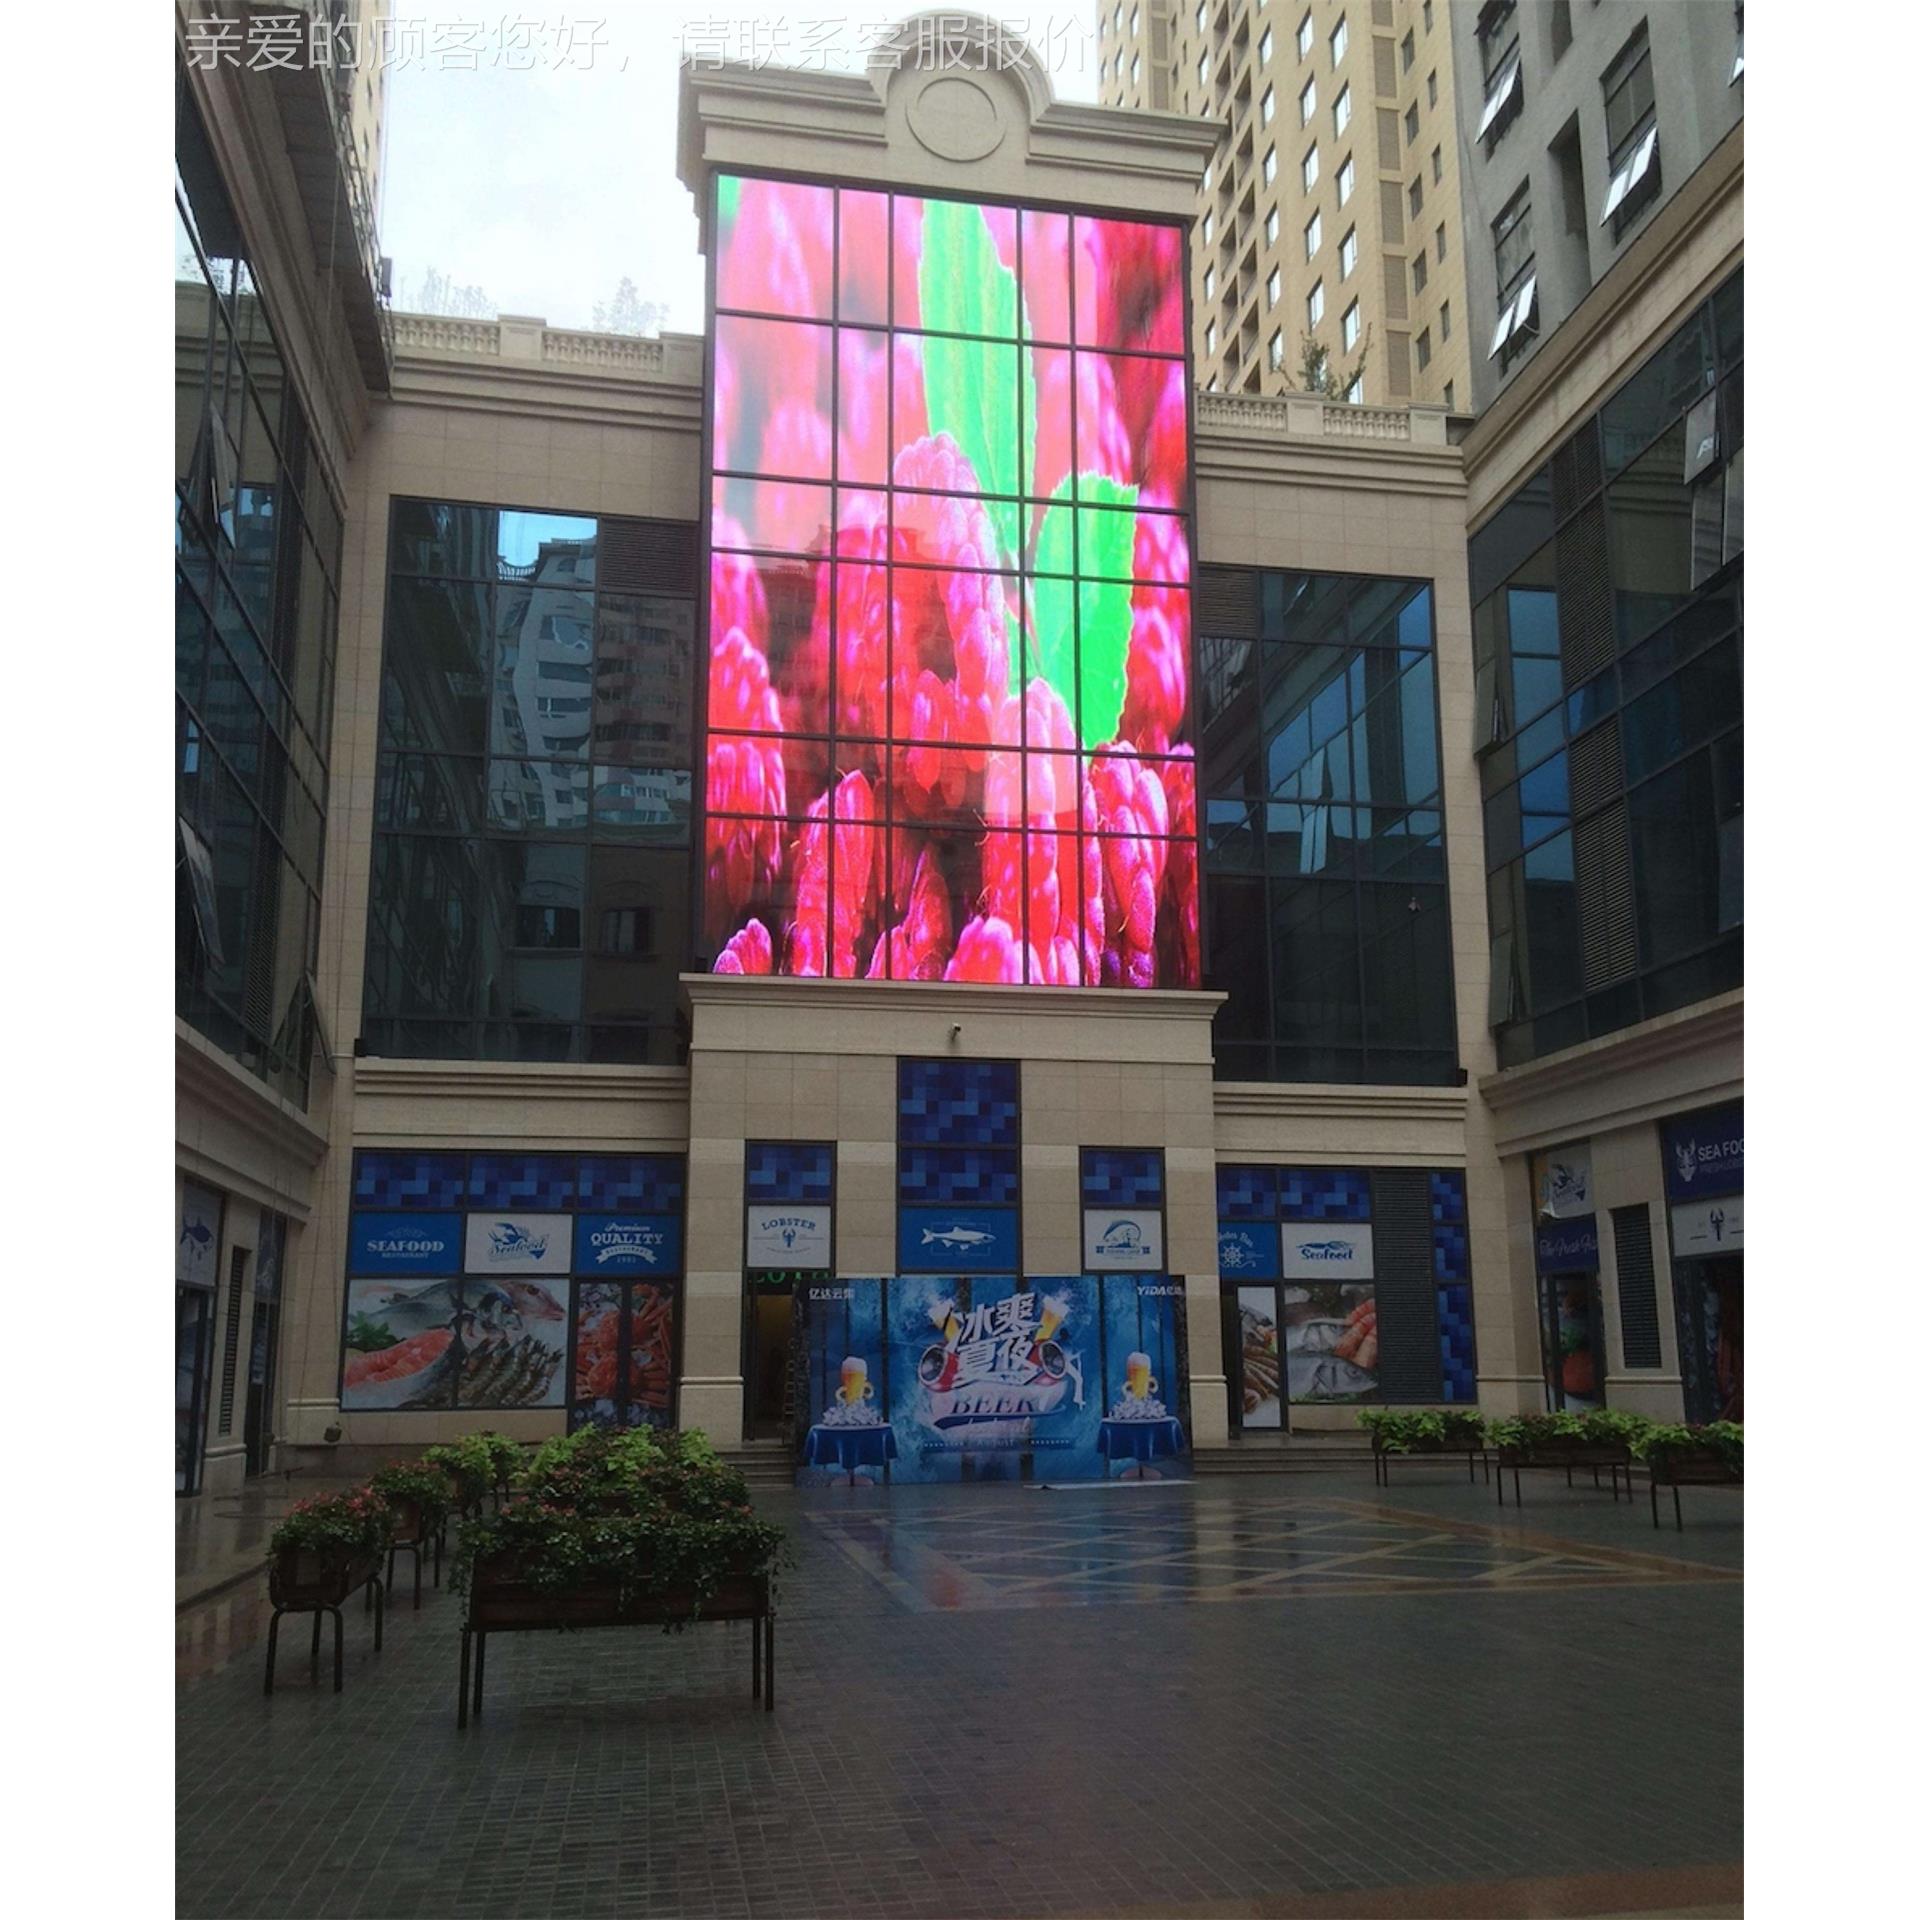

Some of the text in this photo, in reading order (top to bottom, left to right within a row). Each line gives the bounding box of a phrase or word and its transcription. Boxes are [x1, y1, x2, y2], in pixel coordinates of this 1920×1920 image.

[761, 1217, 817, 1231] LOBSTER
[366, 1239, 446, 1253] SEAFOOD
[590, 1232, 664, 1247] QUALITY
[1301, 1247, 1354, 1261] Seafood
[951, 1396, 1035, 1414] BEER
